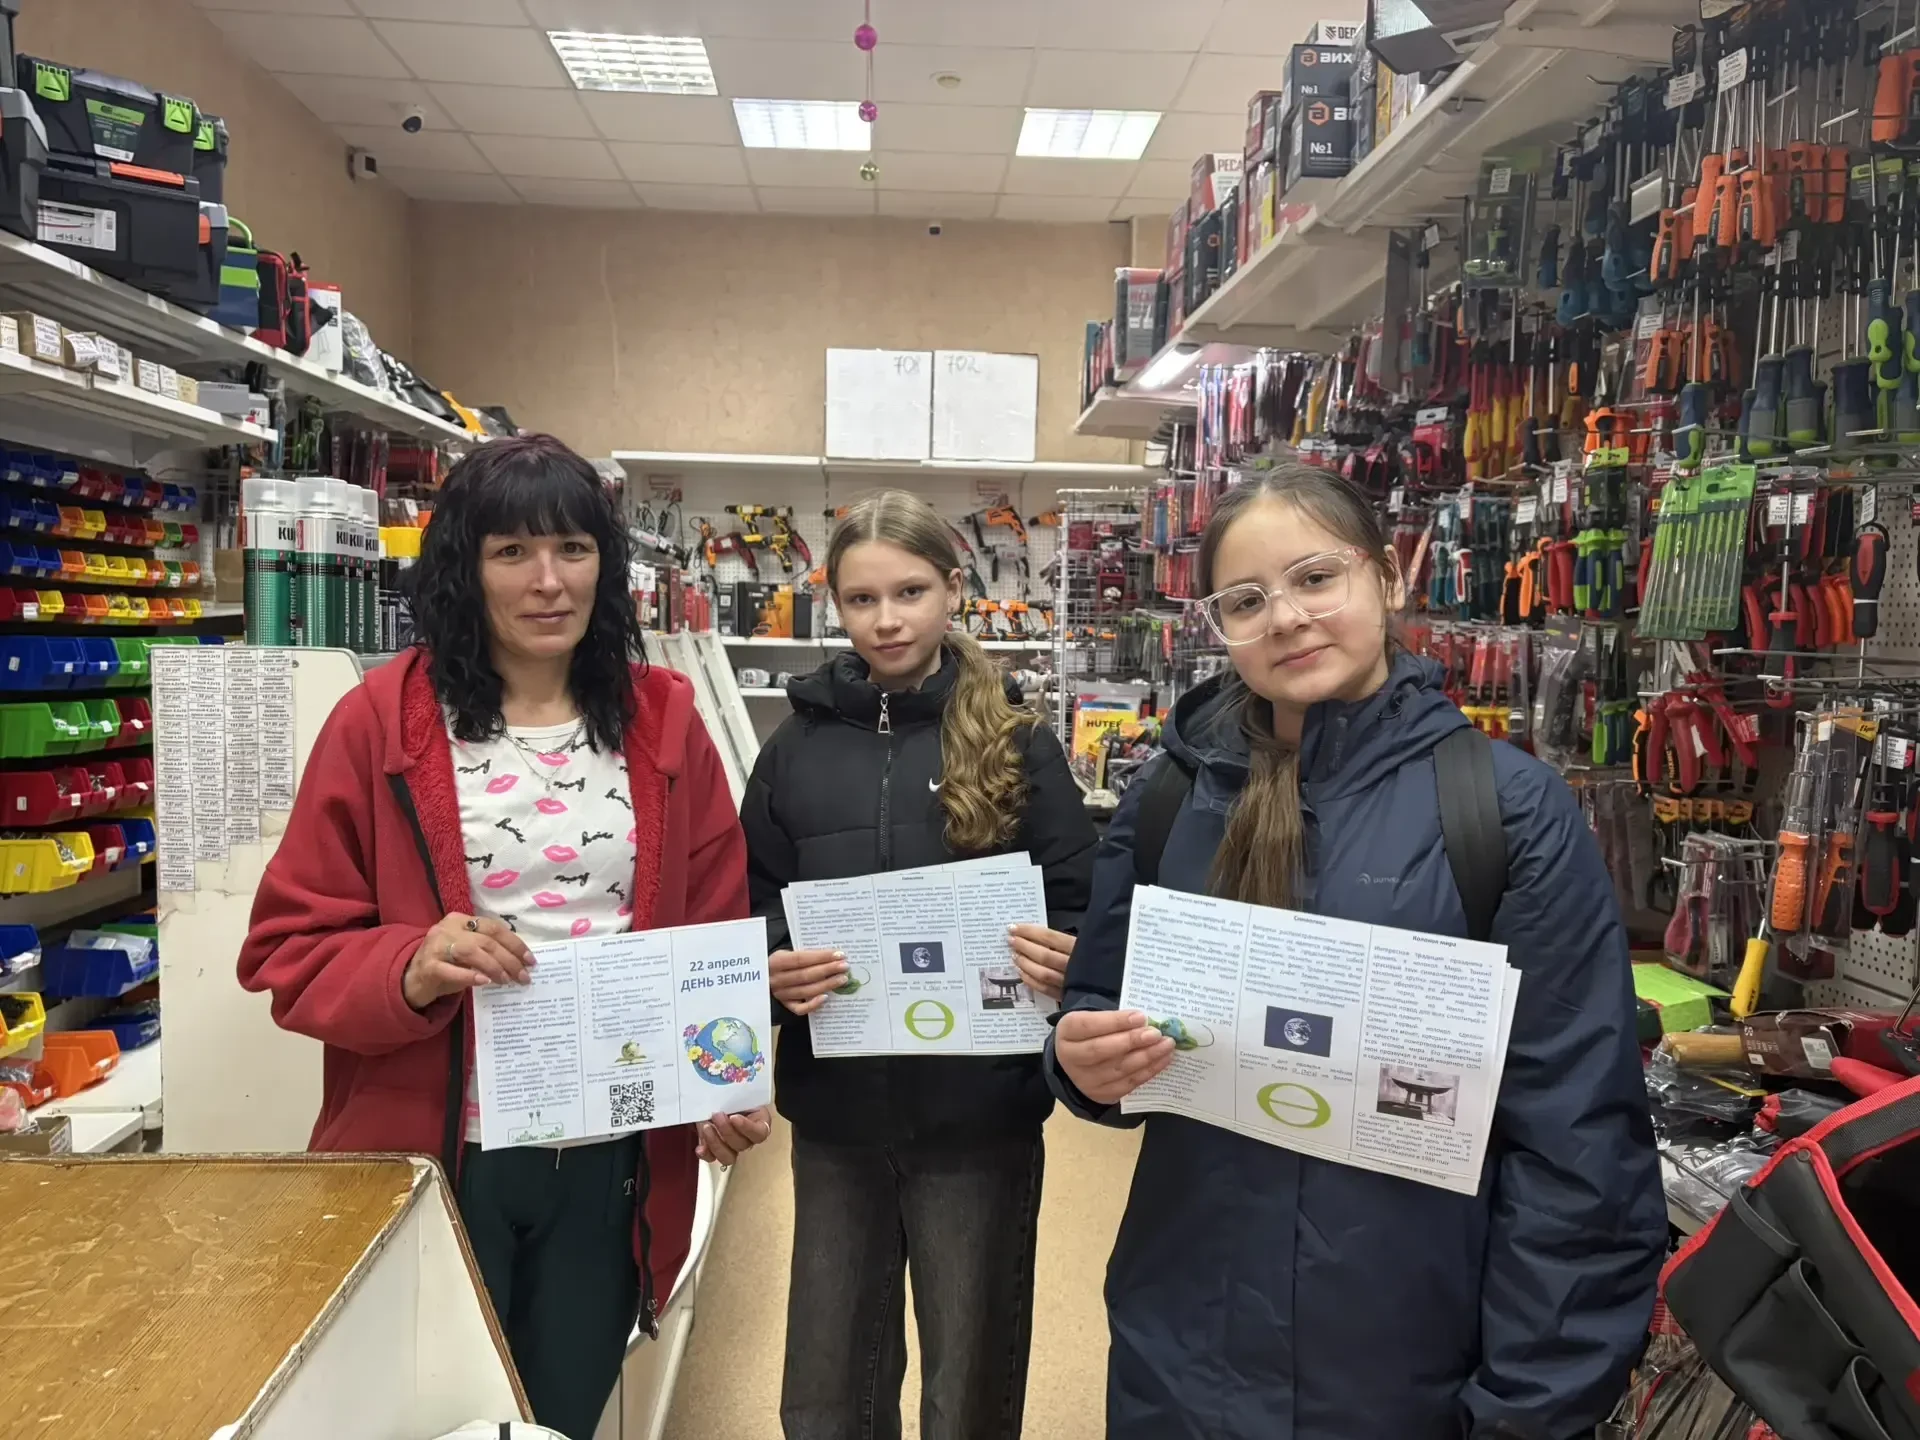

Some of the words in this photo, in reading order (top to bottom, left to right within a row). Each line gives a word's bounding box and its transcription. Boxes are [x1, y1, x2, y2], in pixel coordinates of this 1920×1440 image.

[1320, 53, 1353, 63] ВИХ
[1310, 142, 1332, 154] №1
[279, 527, 295, 541] KU
[337, 531, 348, 544] KU
[350, 534, 363, 547] KU
[366, 538, 379, 551] KU
[689, 961, 705, 972] 22
[707, 955, 750, 972] апреля
[680, 977, 714, 993] ДЕНЬ
[717, 970, 761, 987] ЗЕМЛИ
